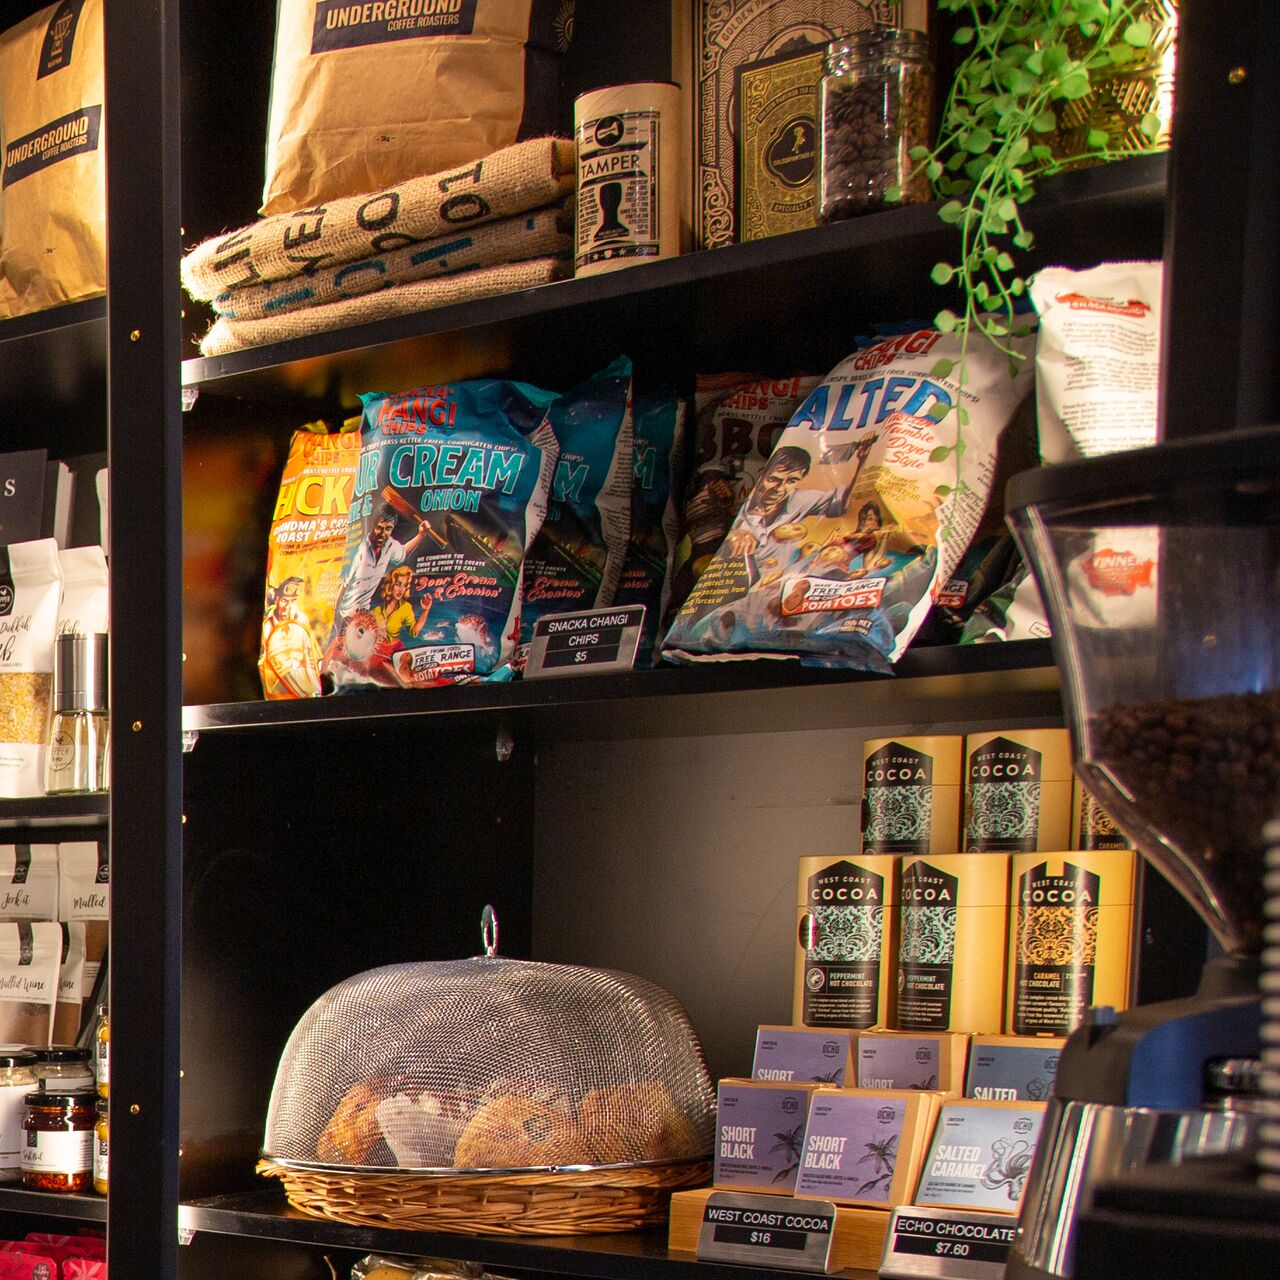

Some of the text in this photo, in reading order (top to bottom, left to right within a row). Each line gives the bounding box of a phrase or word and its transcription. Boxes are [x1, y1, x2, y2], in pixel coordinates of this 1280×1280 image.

[326, 0, 461, 30] UNDERGROUND
[388, 13, 459, 31] COFFEE ROASTERS
[7, 115, 89, 168] UNDERGROUND
[42, 135, 87, 160] COFFEE ROASTERS
[580, 154, 640, 179] TAMPER
[382, 421, 427, 435] CHIPS
[390, 445, 524, 494] CREAM
[420, 488, 481, 512] ONION
[812, 580, 881, 595] FREE RANGE
[802, 592, 877, 611] POTATOES
[548, 614, 628, 632] SNACKA CHANGI
[568, 633, 600, 646] CHIPS
[414, 649, 472, 665] FREE RANGE
[574, 651, 587, 662] $5
[872, 756, 919, 766] WEST COAST
[977, 751, 1028, 762] WEST COAST
[866, 768, 926, 782] COCOA
[971, 764, 1035, 778] COCOA
[818, 876, 870, 885] WEST COAST
[811, 888, 878, 901] COCOA
[1022, 890, 1092, 903] COCOA
[829, 972, 865, 980] PEPPERMINT
[841, 979, 873, 988] CHOCOLATE
[1033, 972, 1060, 981] CARAMEL
[721, 1125, 757, 1143] SHORT
[721, 1142, 754, 1160] BLACK
[808, 1135, 848, 1153] SHORT
[805, 1152, 842, 1170] BLACK
[935, 1145, 981, 1162] SALTED
[931, 1161, 988, 1181] CARAMEL
[708, 1208, 828, 1231] WEST COAST COCOA
[750, 1231, 771, 1244] $16
[935, 1242, 970, 1257] $7.60
